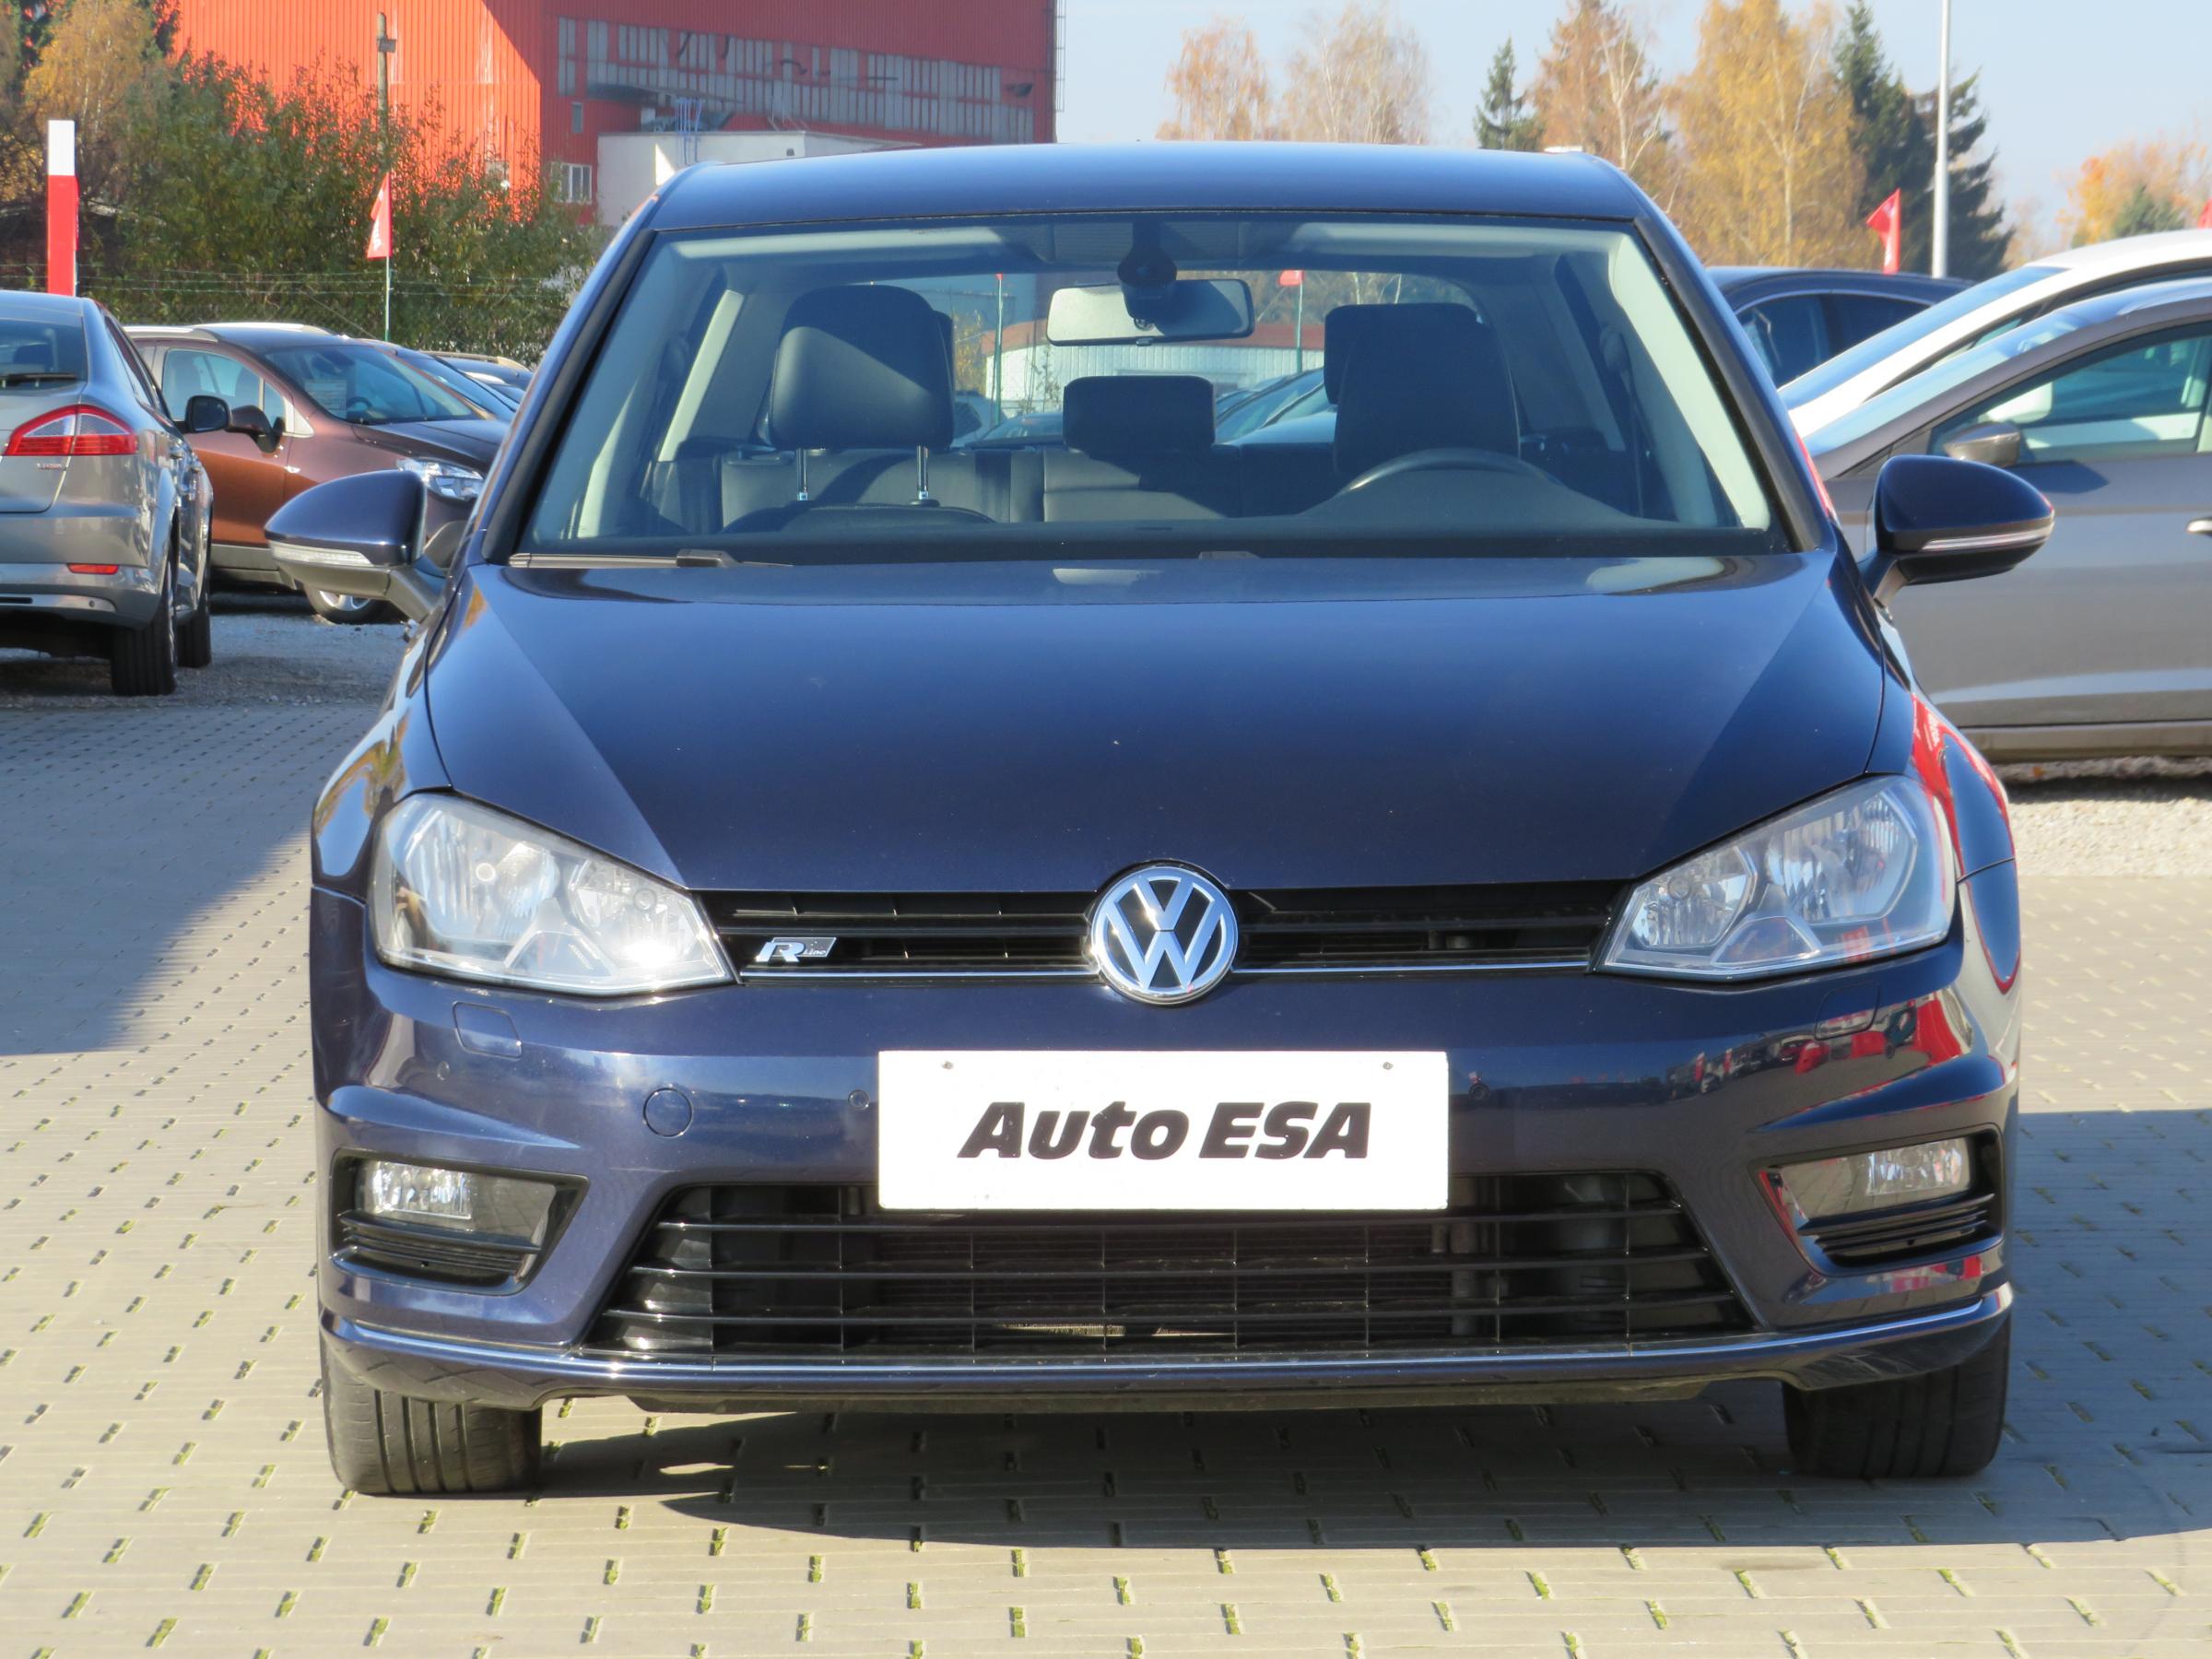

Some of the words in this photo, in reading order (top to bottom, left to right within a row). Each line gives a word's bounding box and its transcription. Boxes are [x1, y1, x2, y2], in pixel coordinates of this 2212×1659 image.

[756, 942, 805, 962] R
[1097, 868, 1231, 998] VW
[957, 1100, 1190, 1160] Auto
[1198, 1100, 1371, 1160] ESA
